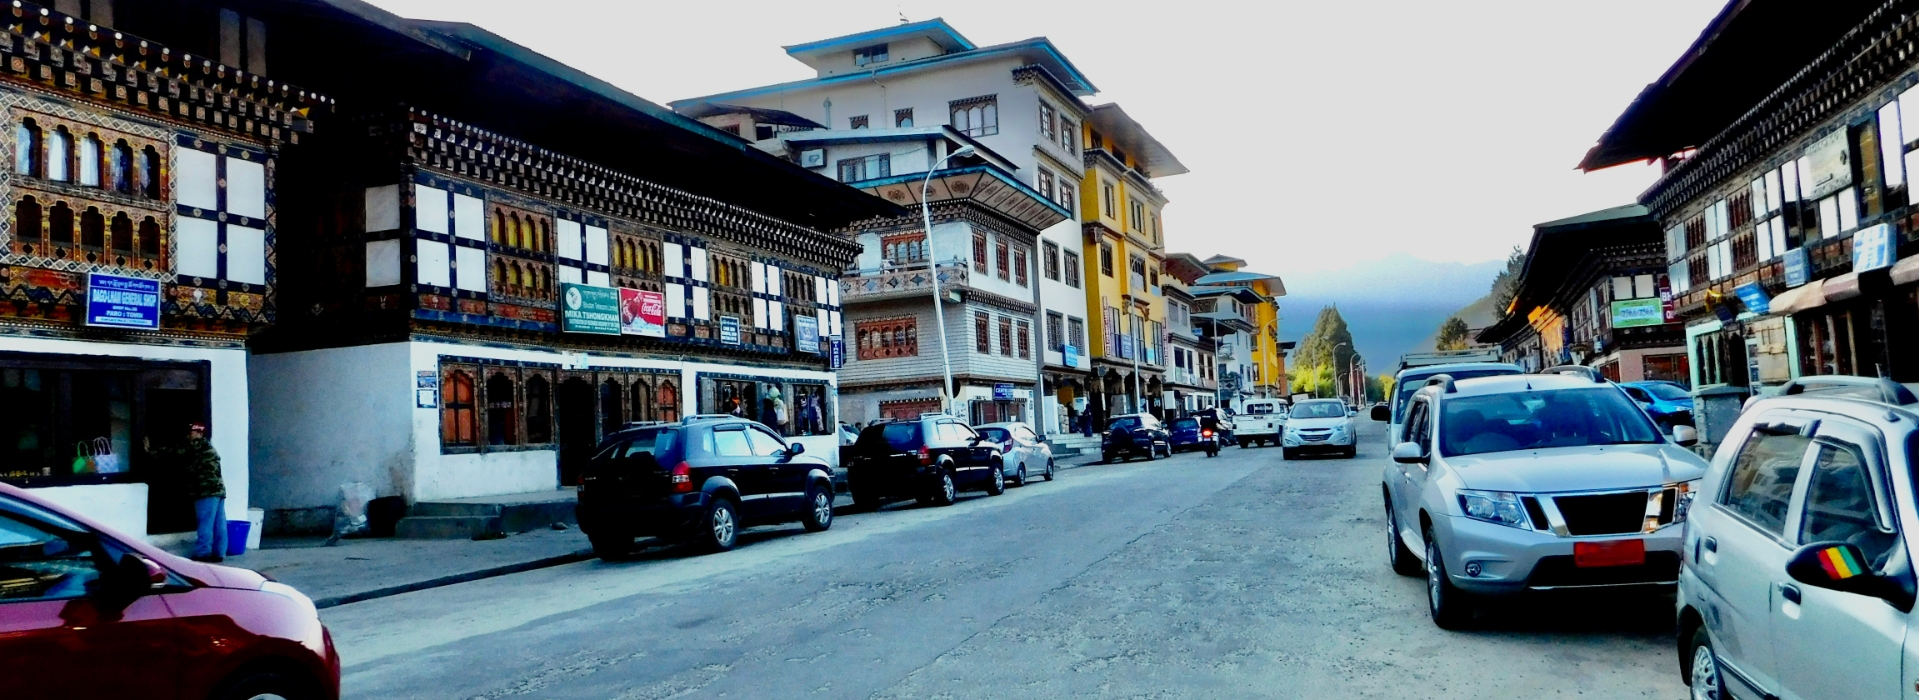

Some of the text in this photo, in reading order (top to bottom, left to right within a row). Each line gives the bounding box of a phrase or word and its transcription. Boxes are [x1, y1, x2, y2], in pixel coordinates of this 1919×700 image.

[122, 292, 143, 306] GENERAL
[144, 294, 156, 307] SHOP
[565, 310, 582, 319] MIKA
[641, 302, 662, 316] Coca-Cola
